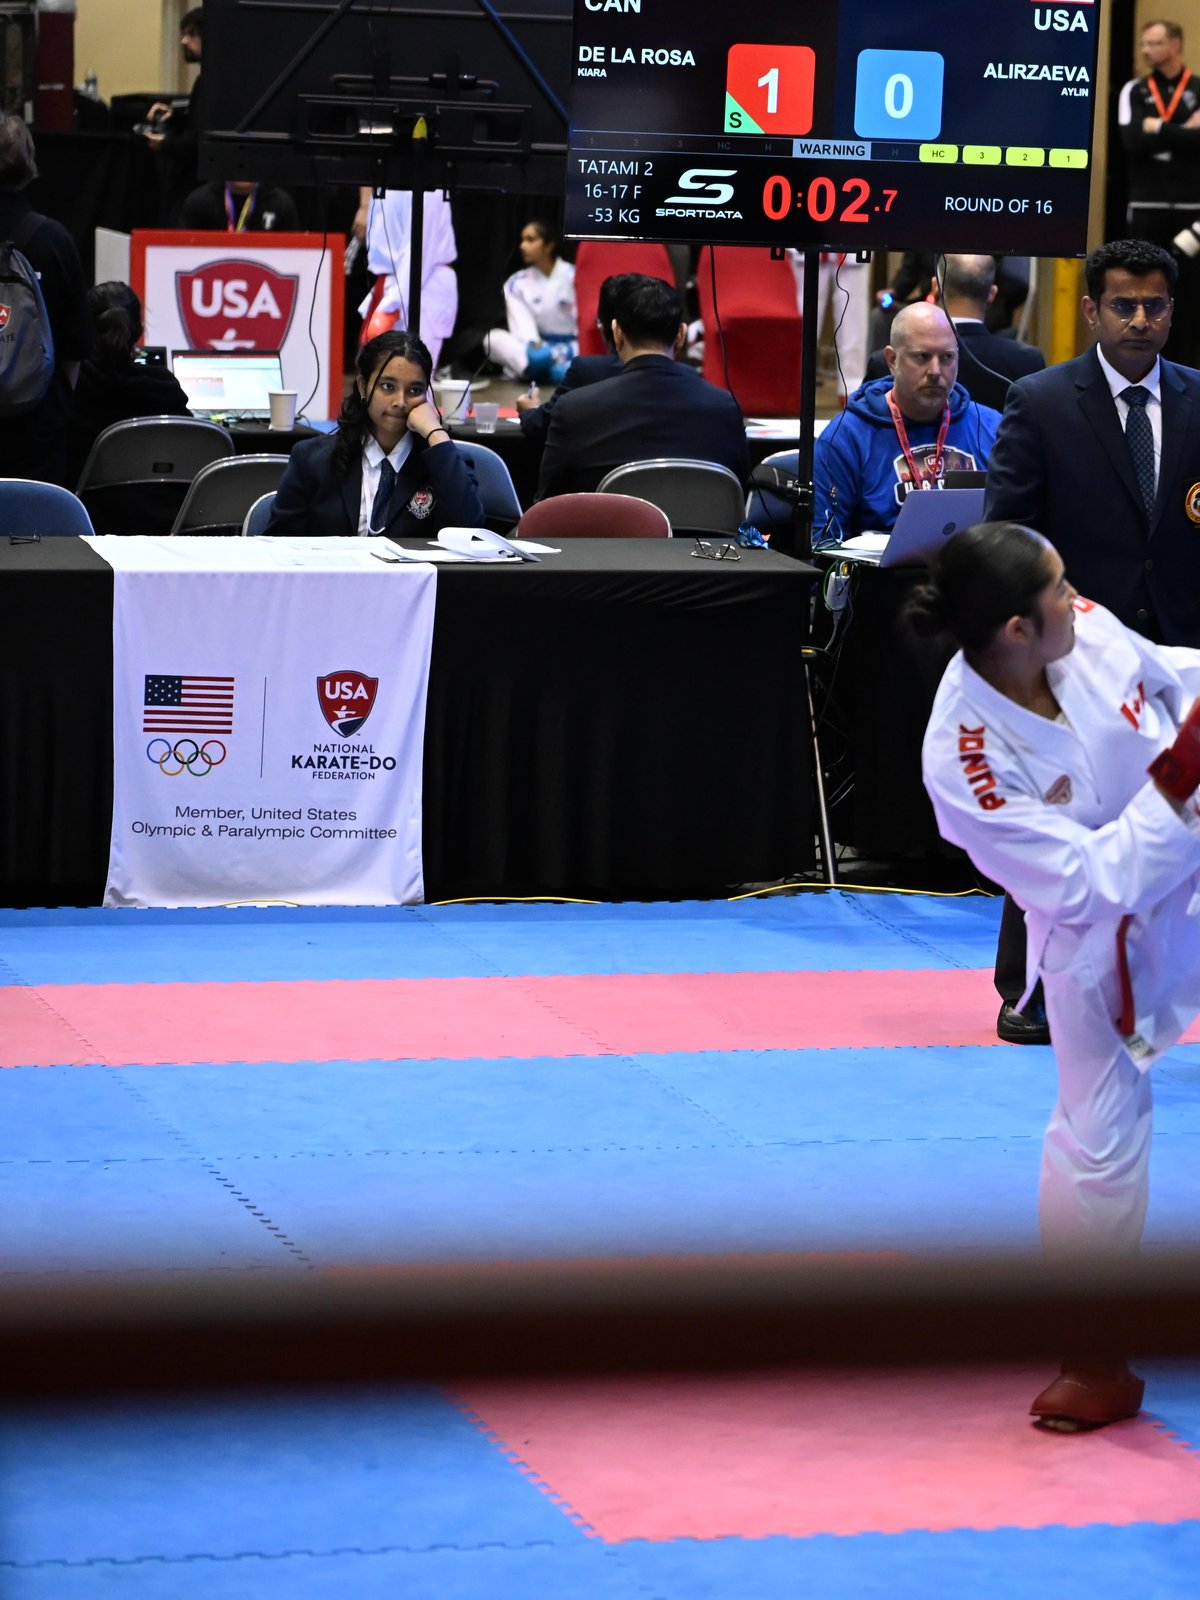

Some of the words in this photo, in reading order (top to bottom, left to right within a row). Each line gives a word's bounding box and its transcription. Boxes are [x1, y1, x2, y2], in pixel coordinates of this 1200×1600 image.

[1034, 8, 1089, 32] USA
[578, 46, 605, 62] DE
[611, 47, 636, 63] LA
[641, 48, 696, 66] ROSA
[577, 68, 607, 77] KIARA
[983, 62, 1090, 82] ALIRZAEVA
[757, 68, 780, 114] 1
[883, 73, 914, 119] 0
[1060, 87, 1089, 97] AYLIN
[728, 112, 742, 129] S
[799, 143, 866, 157] WARNING
[931, 150, 945, 158] HC
[979, 152, 985, 160] 3
[1022, 153, 1028, 161] 2
[578, 159, 639, 176] TATAMI
[644, 161, 653, 176] 2
[584, 183, 628, 199] 16-17
[633, 185, 642, 199] F
[944, 196, 1004, 213] ROUND
[1008, 198, 1030, 214] OF
[1035, 199, 1053, 214] 16
[587, 208, 613, 222] -53
[618, 209, 640, 223] KG
[655, 208, 743, 219] SPORTDATA
[191, 278, 282, 319] USA
[325, 681, 369, 700] USA
[313, 744, 375, 754] NATIONAL
[291, 755, 397, 770] KARATE-DO
[312, 771, 376, 780] FEDERATION
[175, 806, 246, 820] Member,
[251, 807, 302, 820] United
[307, 808, 357, 821] States
[131, 821, 196, 838] Olympic
[201, 825, 213, 837] &
[218, 824, 305, 840] Paralympic
[310, 826, 397, 840] Committee
